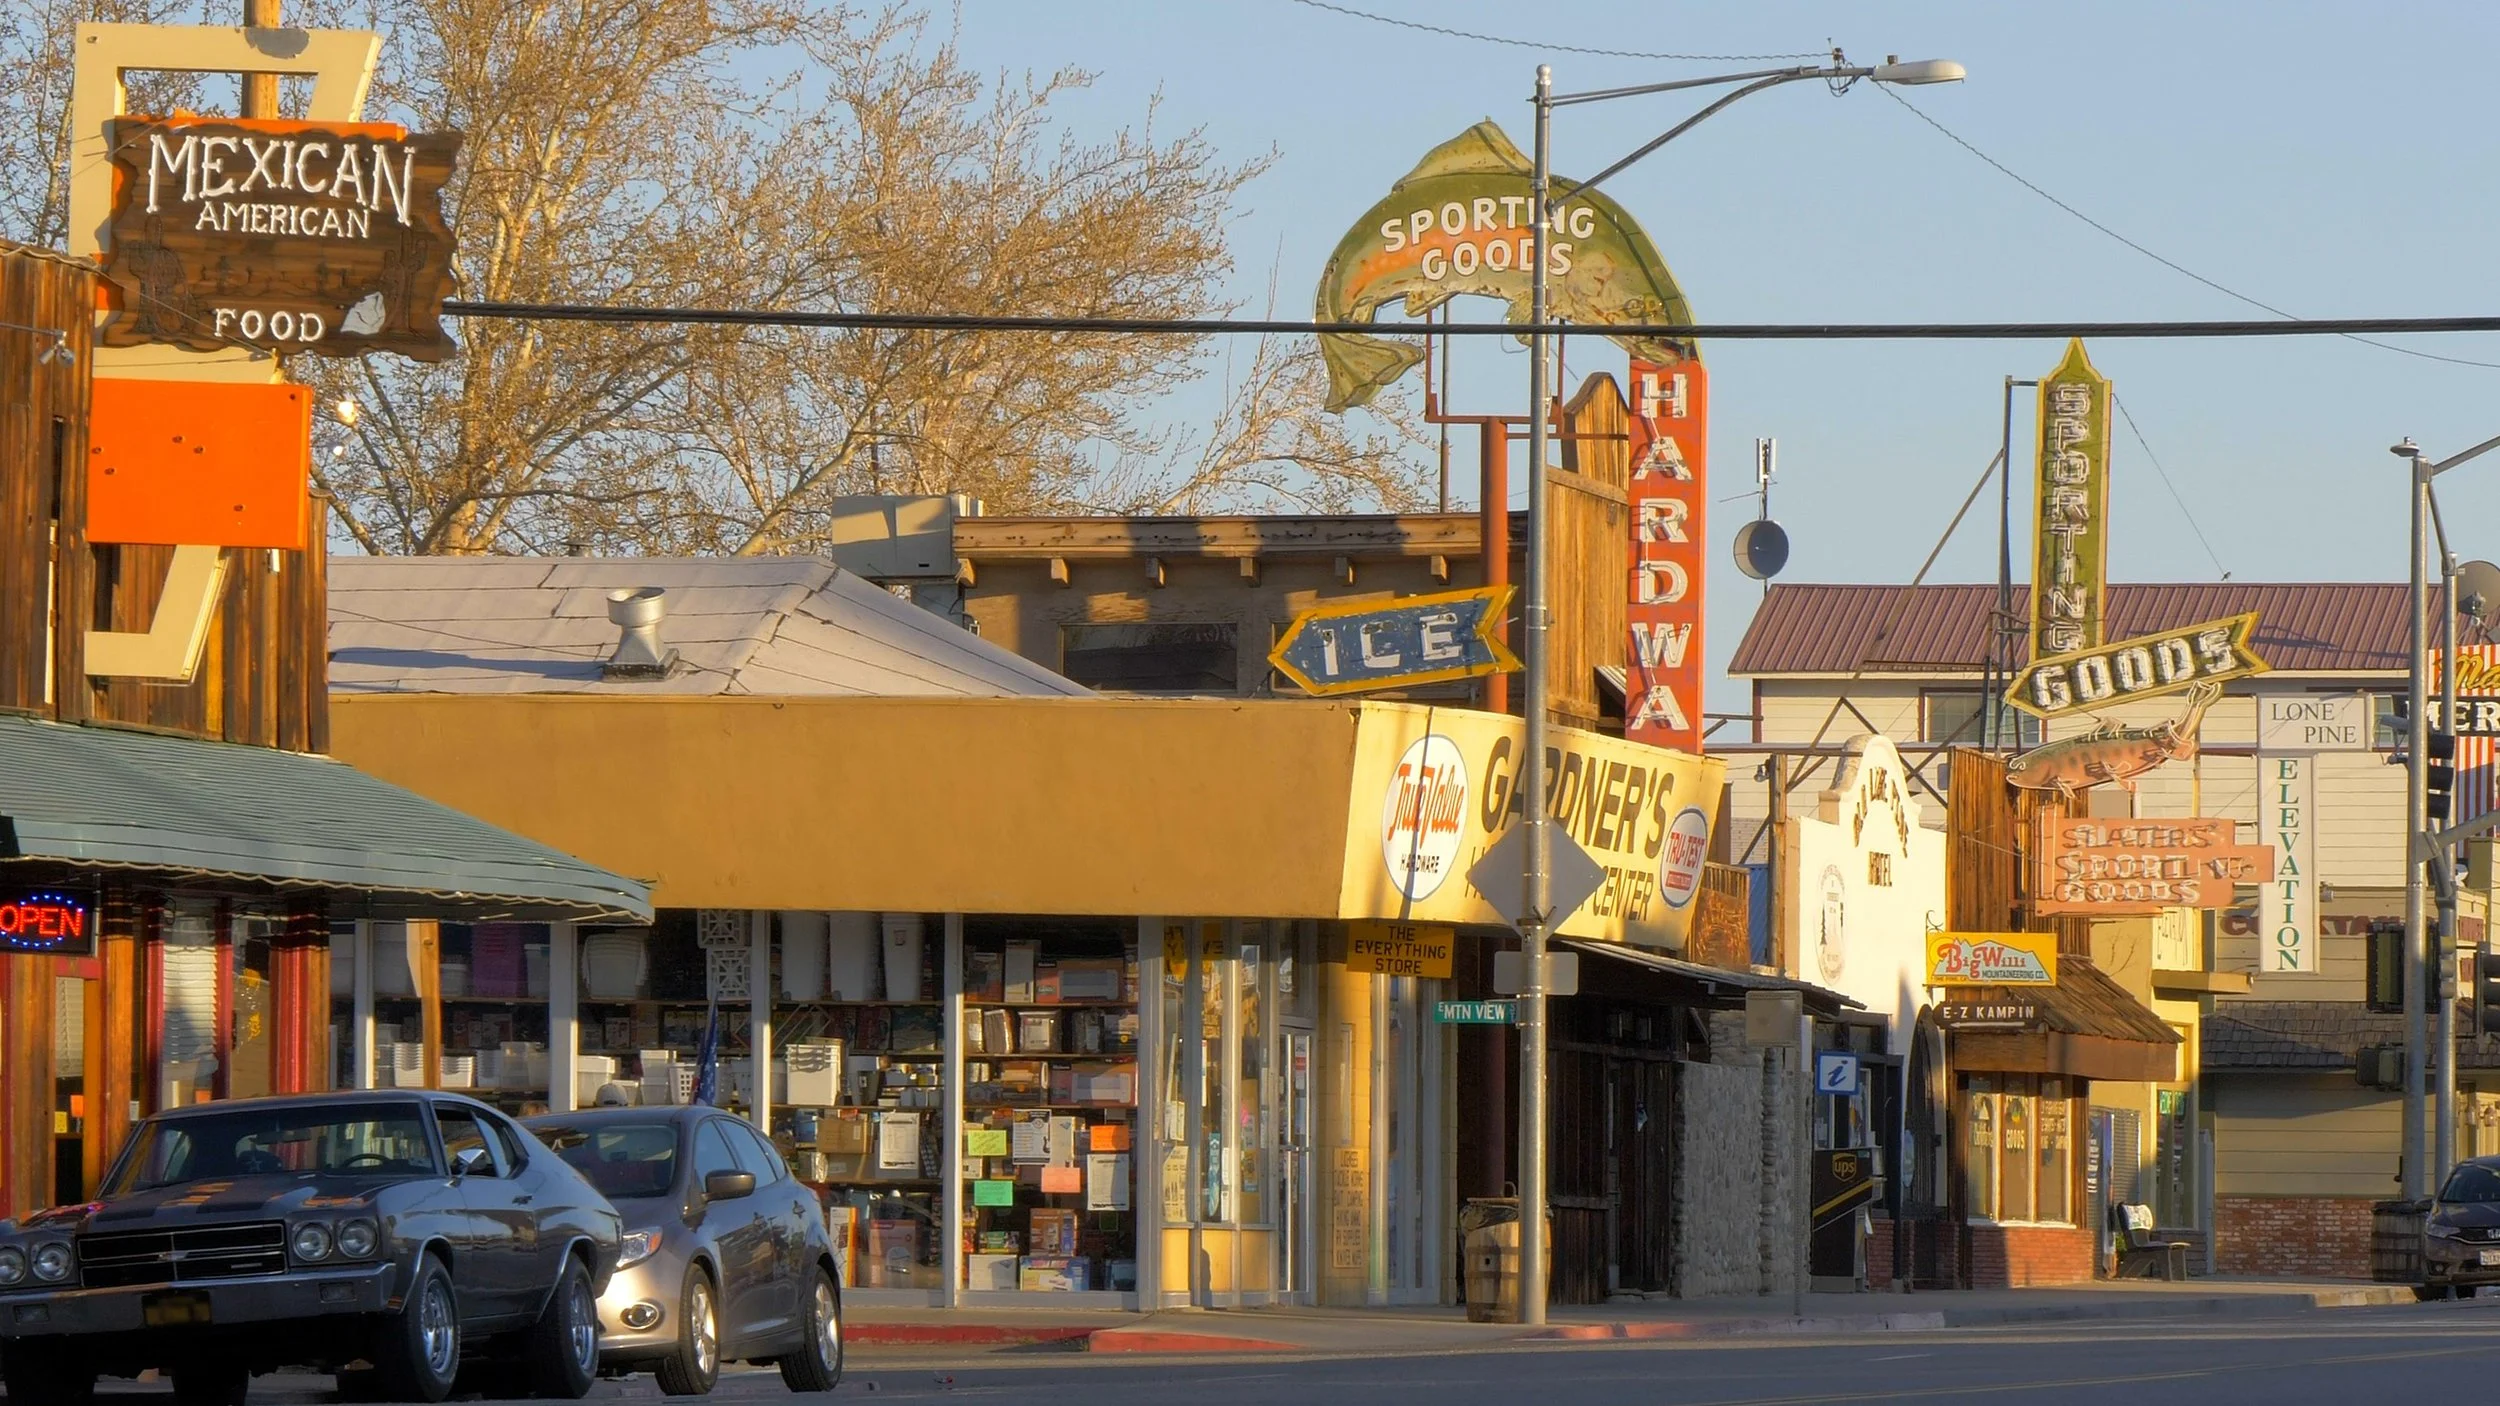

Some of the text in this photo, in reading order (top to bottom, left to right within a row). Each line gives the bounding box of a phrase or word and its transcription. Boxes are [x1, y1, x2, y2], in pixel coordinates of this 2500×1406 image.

[145, 133, 417, 227] MEXICAN
[195, 200, 371, 239] AMERICAN
[1380, 195, 1596, 253] SPORTING
[1421, 238, 1574, 281] GOODS
[214, 308, 327, 342] FOOD
[2050, 383, 2091, 653] SPORTING
[1630, 373, 1692, 731] HARDWA
[1321, 611, 1463, 677] ICE
[2030, 627, 2240, 713] GOODS
[2272, 701, 2335, 722] LONE
[2303, 724, 2357, 744] PINE
[1400, 853, 1440, 874] HARDWARE
[2277, 759, 2302, 971] ELEVATION
[1593, 865, 1655, 922] CENTER
[0, 905, 82, 936] OPEN
[1388, 925, 1416, 942] THE
[1354, 939, 1447, 960] EVERYTHING
[1375, 957, 1422, 974] STORE
[1937, 943, 1980, 978] Big
[1438, 1001, 1445, 1013] E
[1444, 1003, 1471, 1020] MTN
[1475, 1003, 1505, 1020] VIEW
[1943, 1006, 2034, 1019] E-Z KAMPIN
[1834, 1160, 1855, 1177] ups
